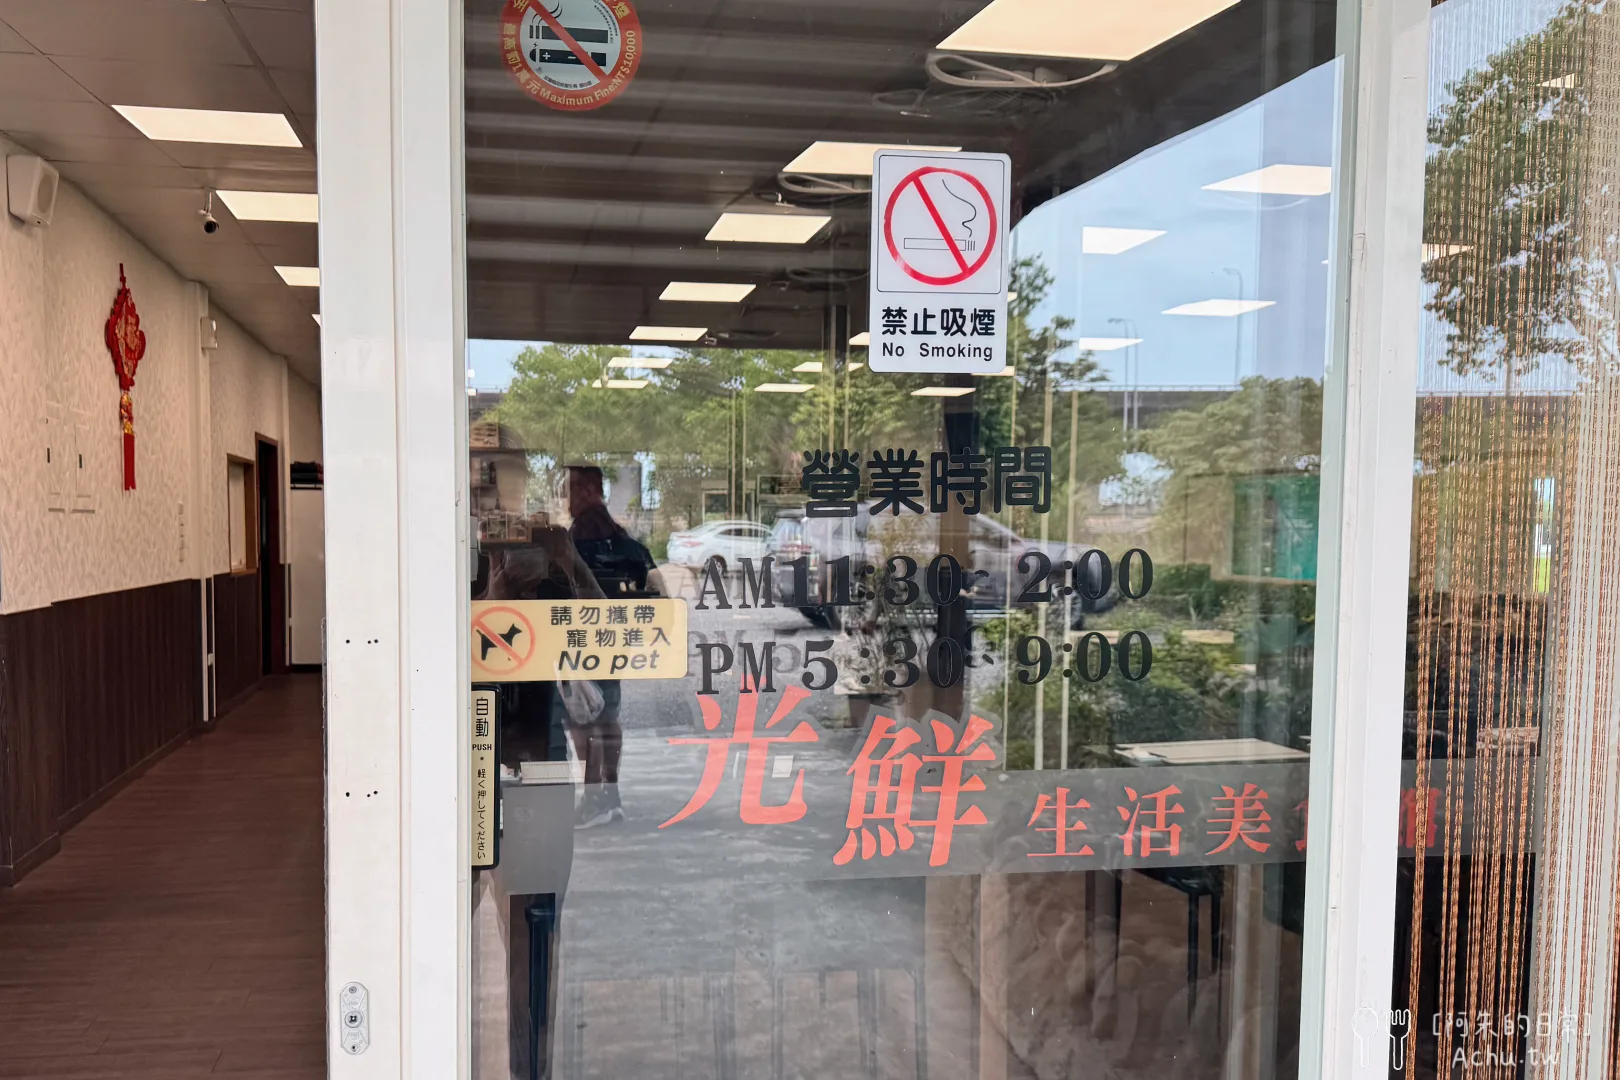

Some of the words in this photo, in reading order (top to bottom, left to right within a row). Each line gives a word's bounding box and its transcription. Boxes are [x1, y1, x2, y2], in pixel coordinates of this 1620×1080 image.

[539, 90, 594, 106] Maximum
[881, 306, 996, 337] 禁止吸煙
[882, 342, 905, 357] No
[919, 342, 993, 362] Smoking
[801, 446, 1051, 517] 營業時間
[1016, 548, 1154, 603] 2:00
[550, 605, 656, 626] 請勿攜帶
[566, 627, 672, 648] 寵物進入
[558, 650, 601, 671] No
[609, 650, 660, 675] pet
[695, 641, 777, 695] PM
[1016, 630, 1153, 685] 9:00
[475, 697, 489, 737] 自動
[471, 743, 492, 751] PUSH
[1026, 782, 1309, 857] 生活美
